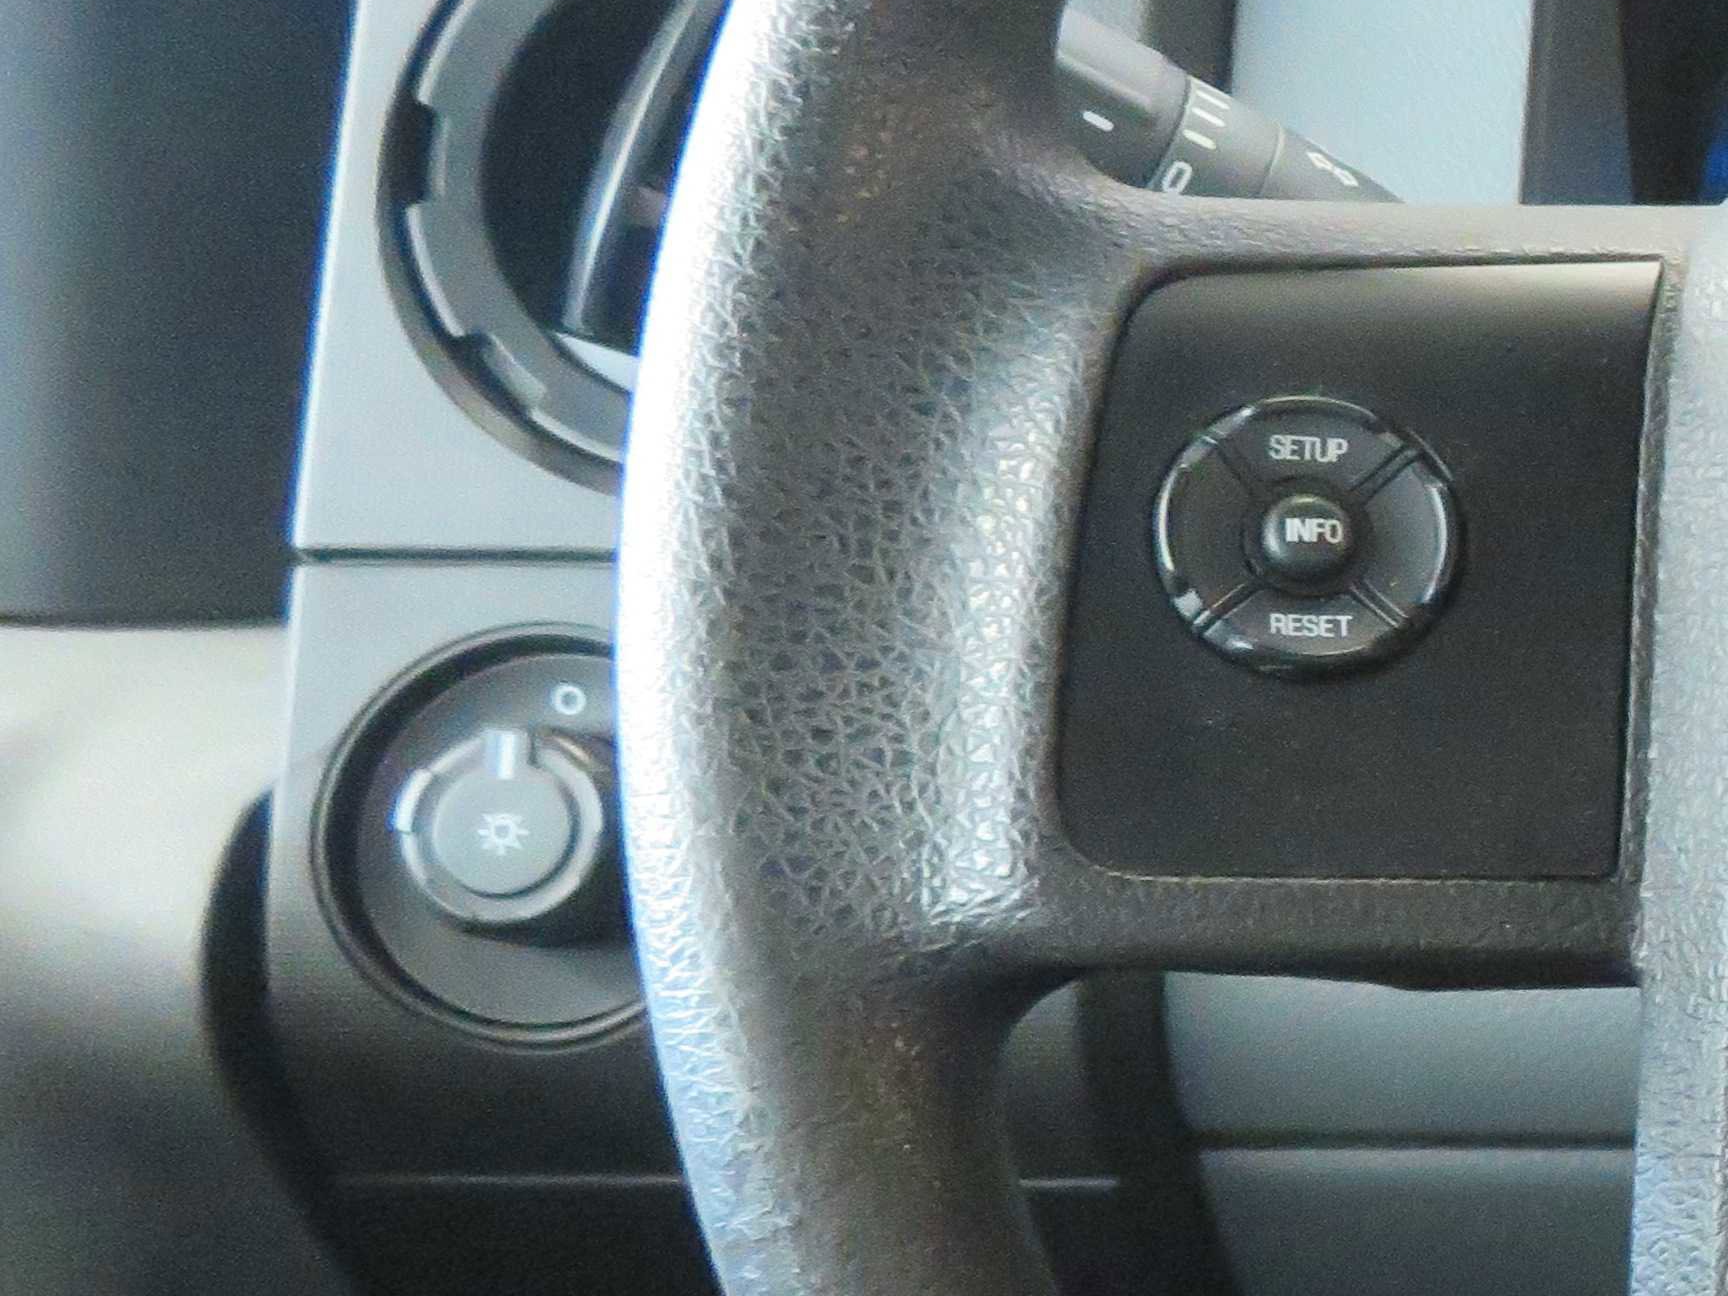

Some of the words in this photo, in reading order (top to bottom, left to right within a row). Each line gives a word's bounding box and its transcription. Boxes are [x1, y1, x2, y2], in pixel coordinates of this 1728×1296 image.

[1268, 434, 1349, 464] SETUP
[1284, 517, 1344, 544] INFO
[1269, 612, 1353, 638] RESET
